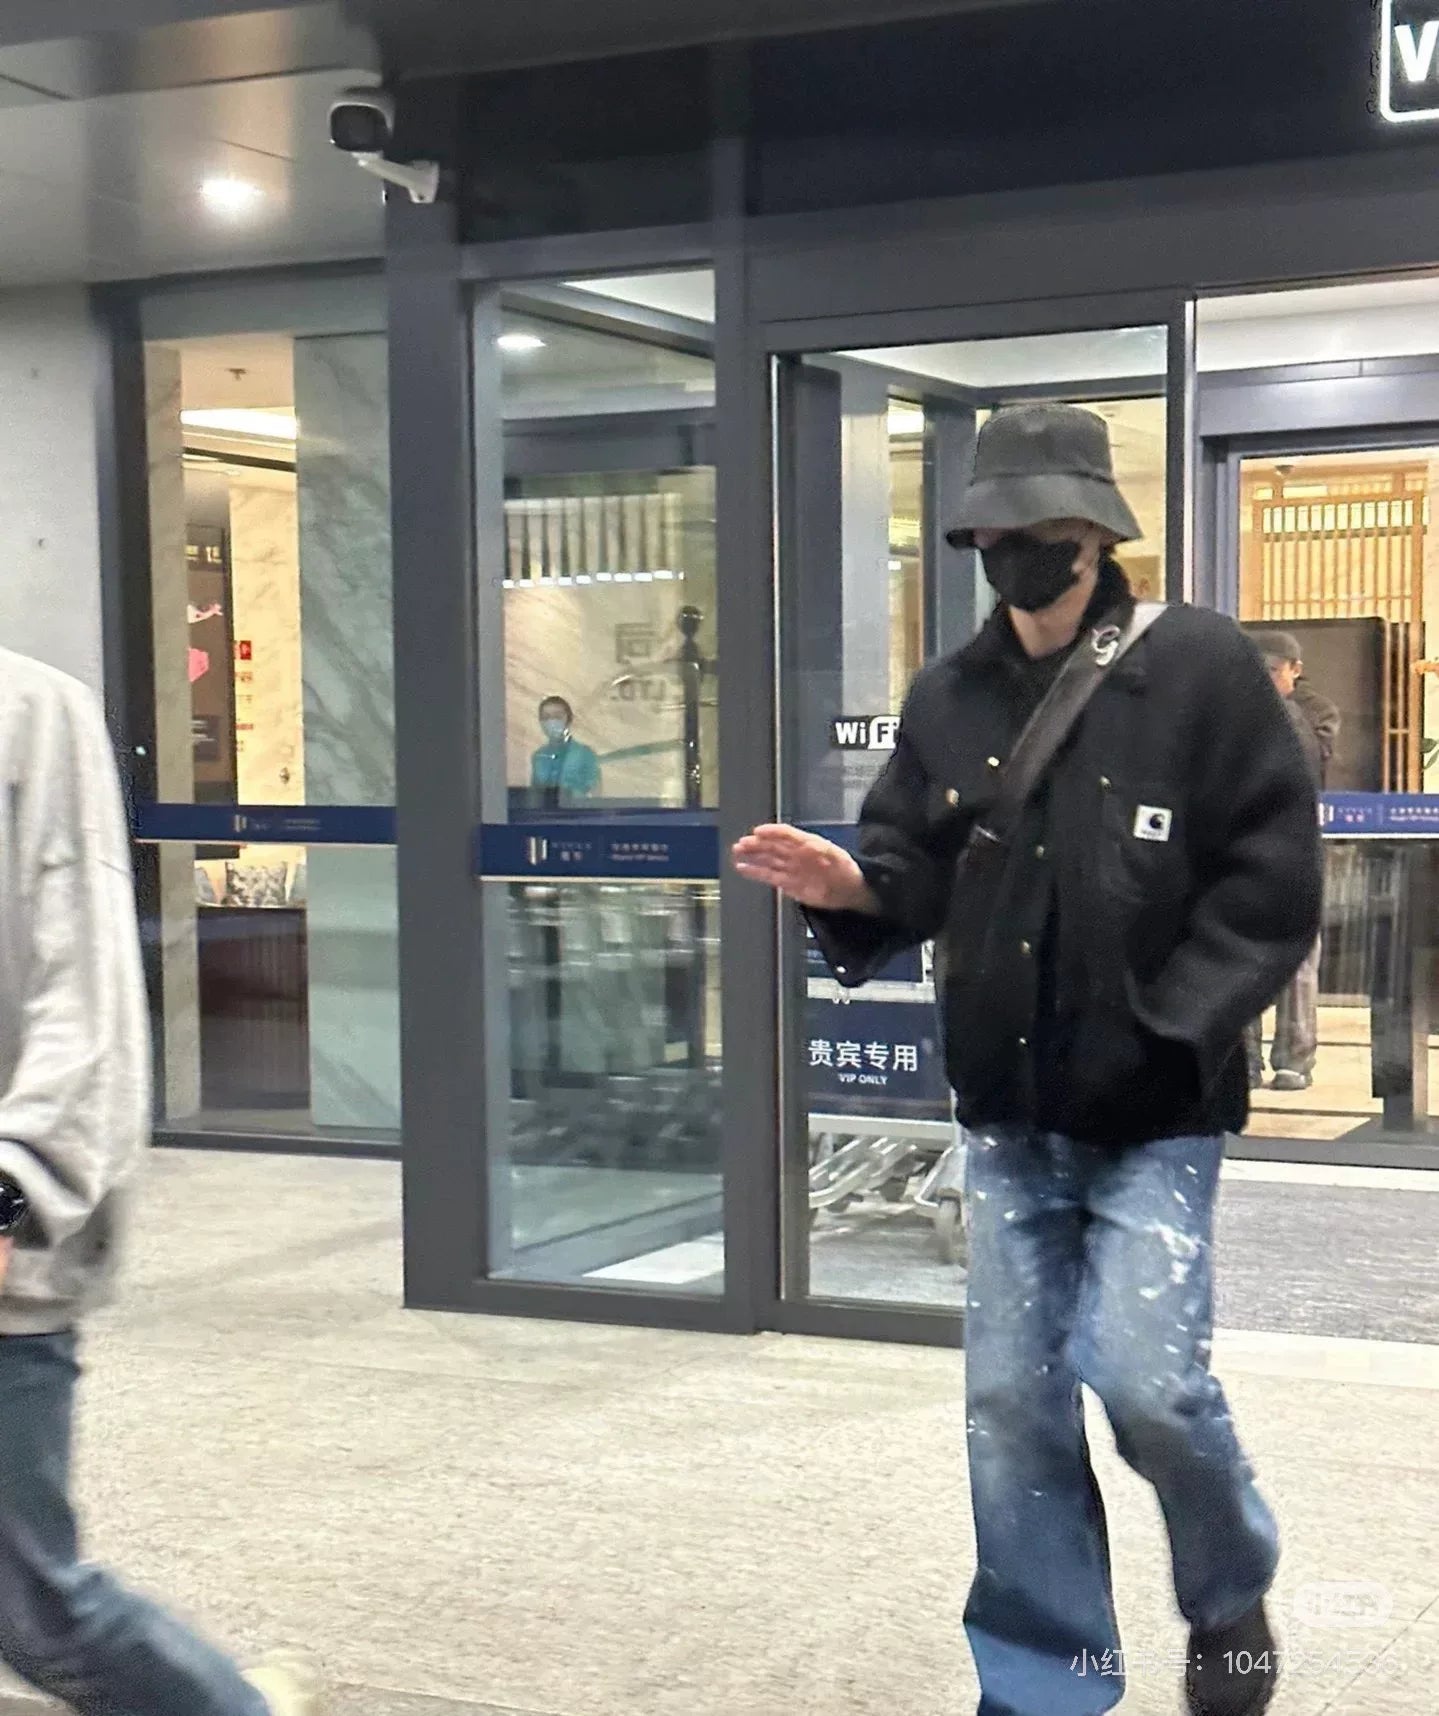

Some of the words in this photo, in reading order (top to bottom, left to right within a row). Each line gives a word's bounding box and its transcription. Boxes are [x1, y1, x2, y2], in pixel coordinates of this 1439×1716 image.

[808, 1039, 918, 1072] 贵宾专用
[839, 1073, 857, 1083] VIP
[858, 1074, 888, 1085] ONLY
